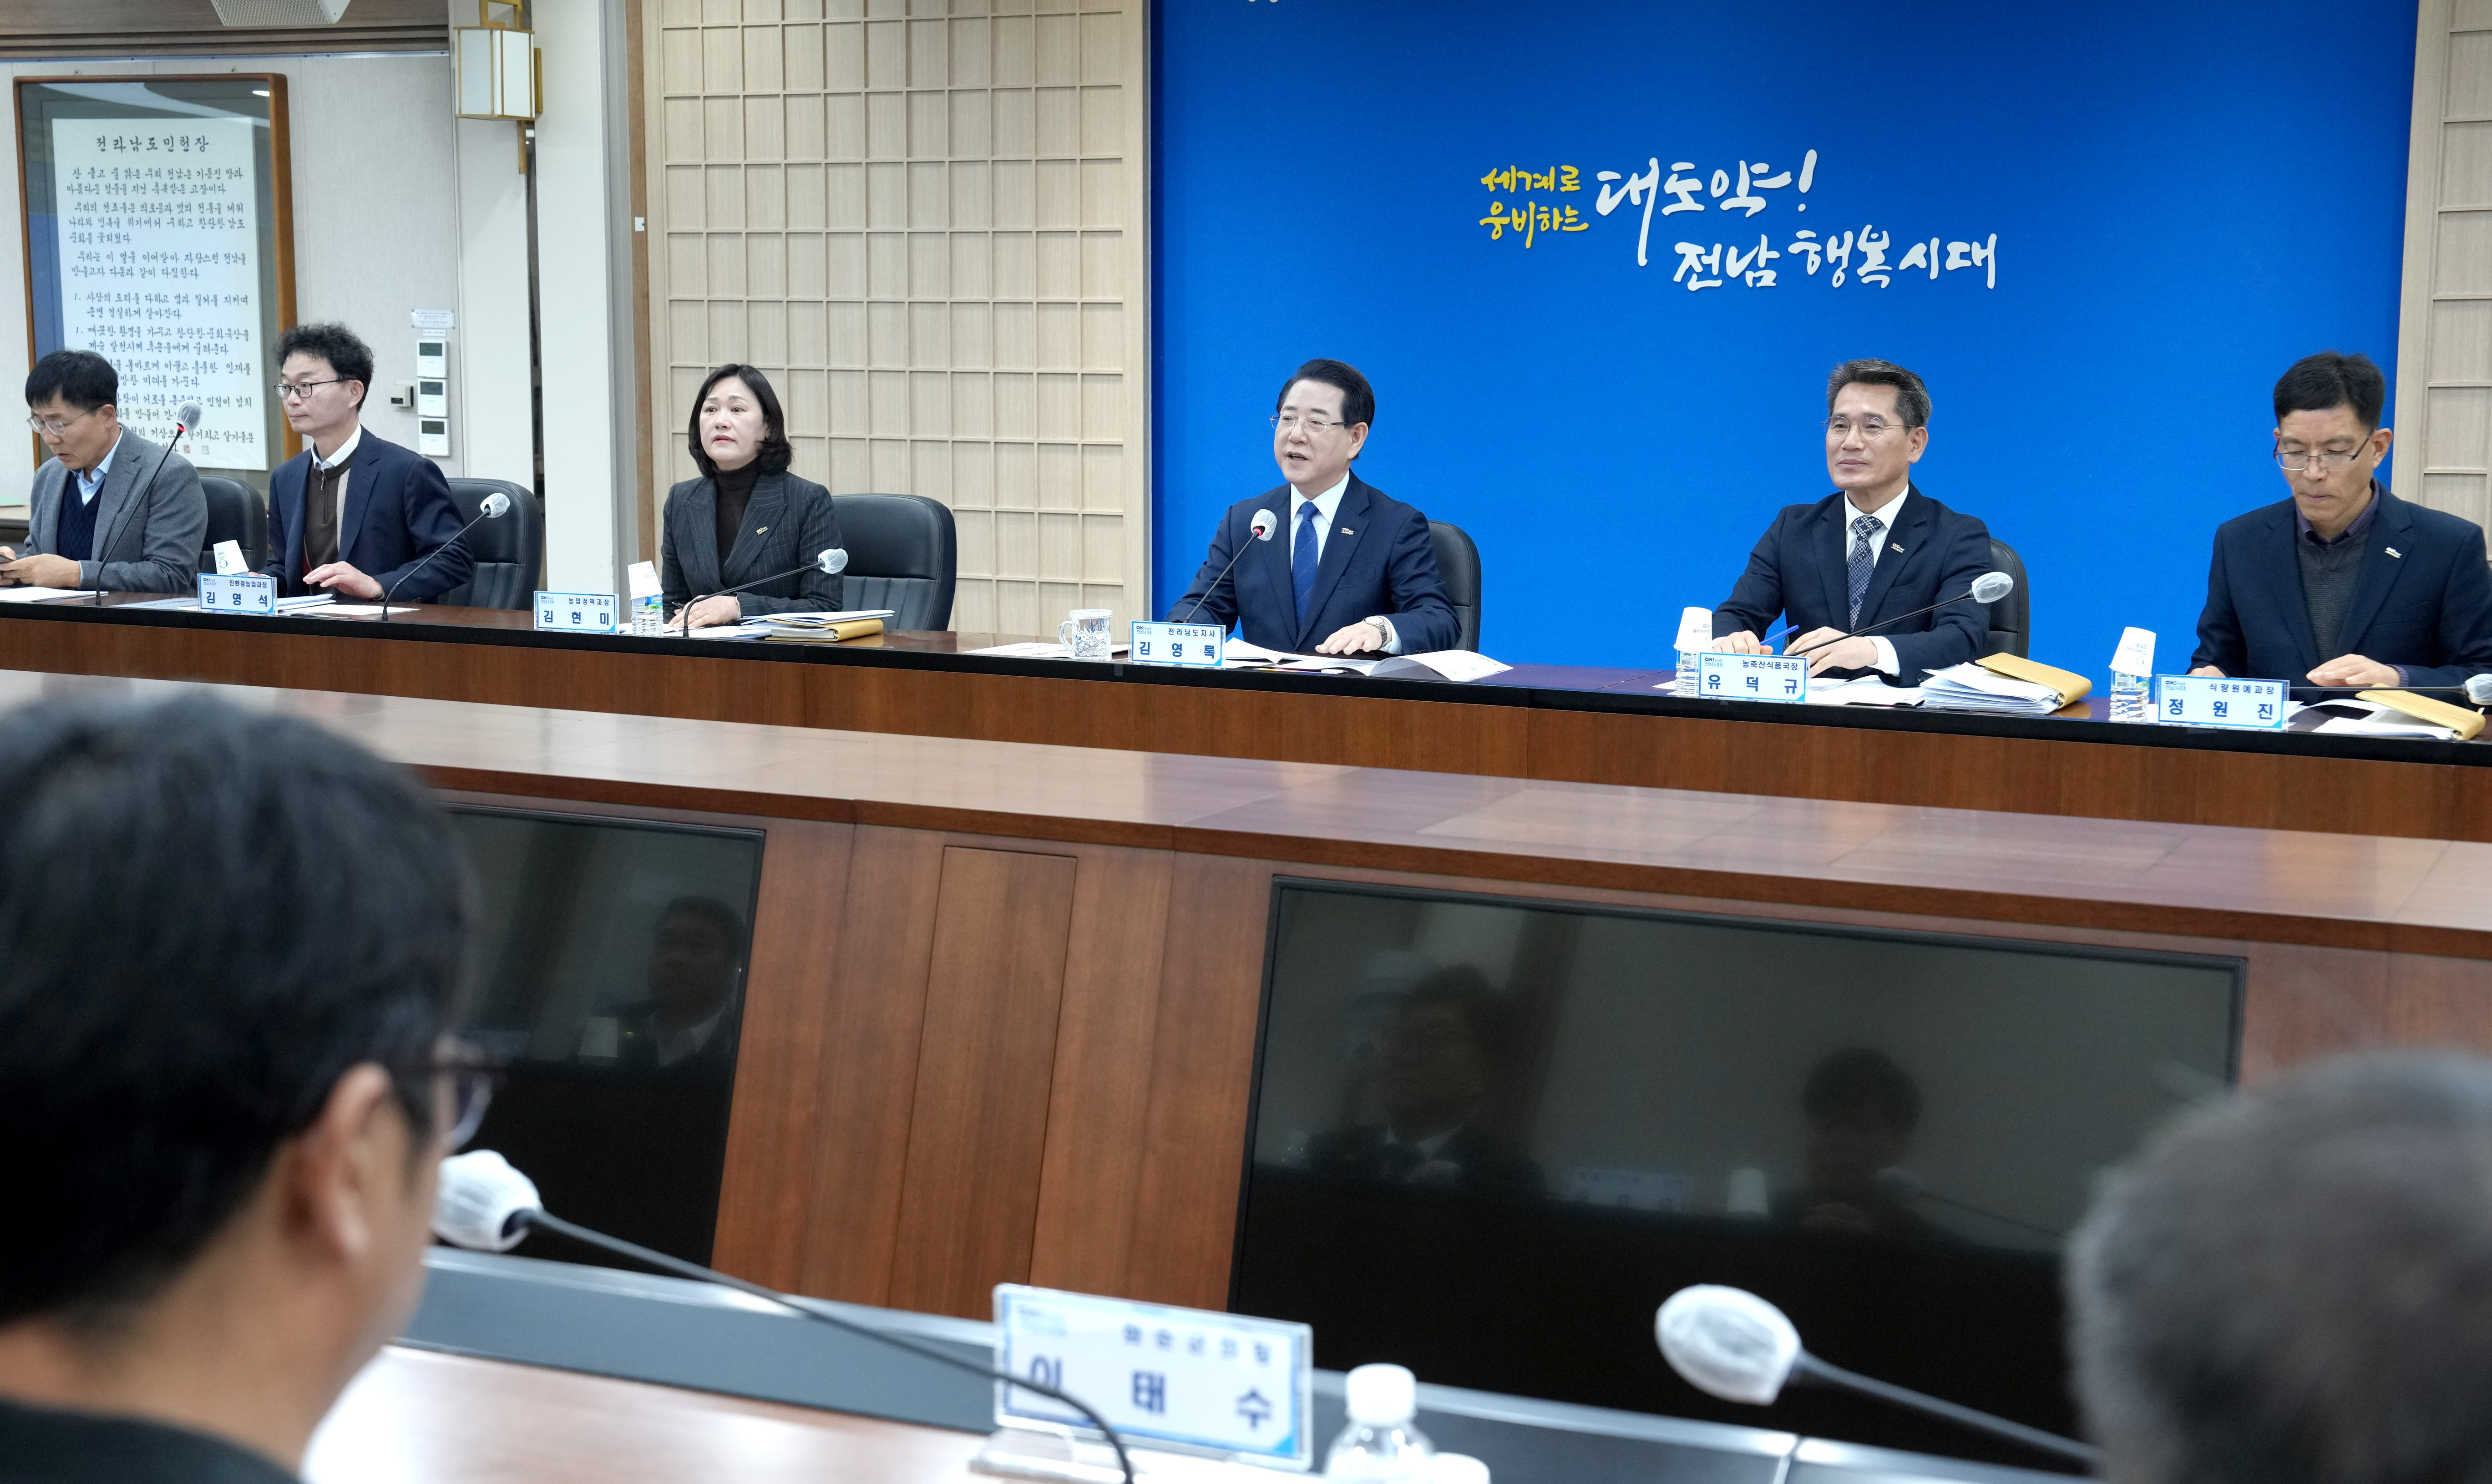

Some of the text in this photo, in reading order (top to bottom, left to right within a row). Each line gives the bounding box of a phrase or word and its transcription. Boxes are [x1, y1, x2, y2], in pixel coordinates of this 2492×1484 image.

[96, 135, 209, 154] 전라남도민헌장
[72, 167, 243, 180] 산 좋고 물 맑은 우리 전남은 기름진 땅과
[1481, 165, 1580, 192] 세계로
[67, 182, 226, 195] 아름다운 섬들을 지닌 축복받은 고장이다
[75, 202, 243, 213] 우리의 선조들은 의로움과 멋의 전통을 세워
[1596, 149, 1817, 266] 대도약!
[69, 217, 245, 228] 나라와 민족을 위기에서 구하고 찬란한 남도
[1479, 201, 1589, 248] 웅비하는
[70, 232, 92, 244] 문화를
[78, 251, 100, 262] 우리는
[106, 251, 113, 263] 이
[142, 251, 179, 263] 이어받아
[184, 252, 218, 264] 자랑스런
[223, 253, 246, 265] 전남을
[1674, 234, 1780, 291] 전남
[71, 265, 105, 278] 만들고자
[109, 266, 135, 279] 다음과
[139, 266, 155, 279] 같이
[86, 292, 110, 303] 사람의
[115, 292, 139, 304] 도리를
[145, 292, 169, 304] 다하고
[174, 292, 190, 304] 법과
[195, 294, 218, 306] 질서를
[223, 294, 248, 306] 지키며
[87, 307, 103, 318] 근면
[109, 307, 141, 319] 성실하게
[87, 324, 116, 336] 깨끗한
[119, 325, 142, 338] 환경을
[147, 326, 172, 338] 가꾸고
[88, 339, 105, 352] 계승
[110, 340, 142, 352] 발전시켜
[147, 340, 189, 354] 후손들에게
[126, 359, 159, 372] 올바르게
[164, 360, 189, 372] 이끌고
[226, 362, 251, 375] 인재를
[143, 374, 167, 387] 미래를
[143, 394, 166, 406] 서로를
[207, 396, 230, 408] 인정이
[229, 580, 267, 588] 친환경농업과장
[569, 598, 609, 606] 농업정책과장
[1169, 628, 1215, 637] 전라남도지사
[1742, 660, 1798, 670] 농축산식품국장
[2209, 684, 2274, 694] 식량원예과장
